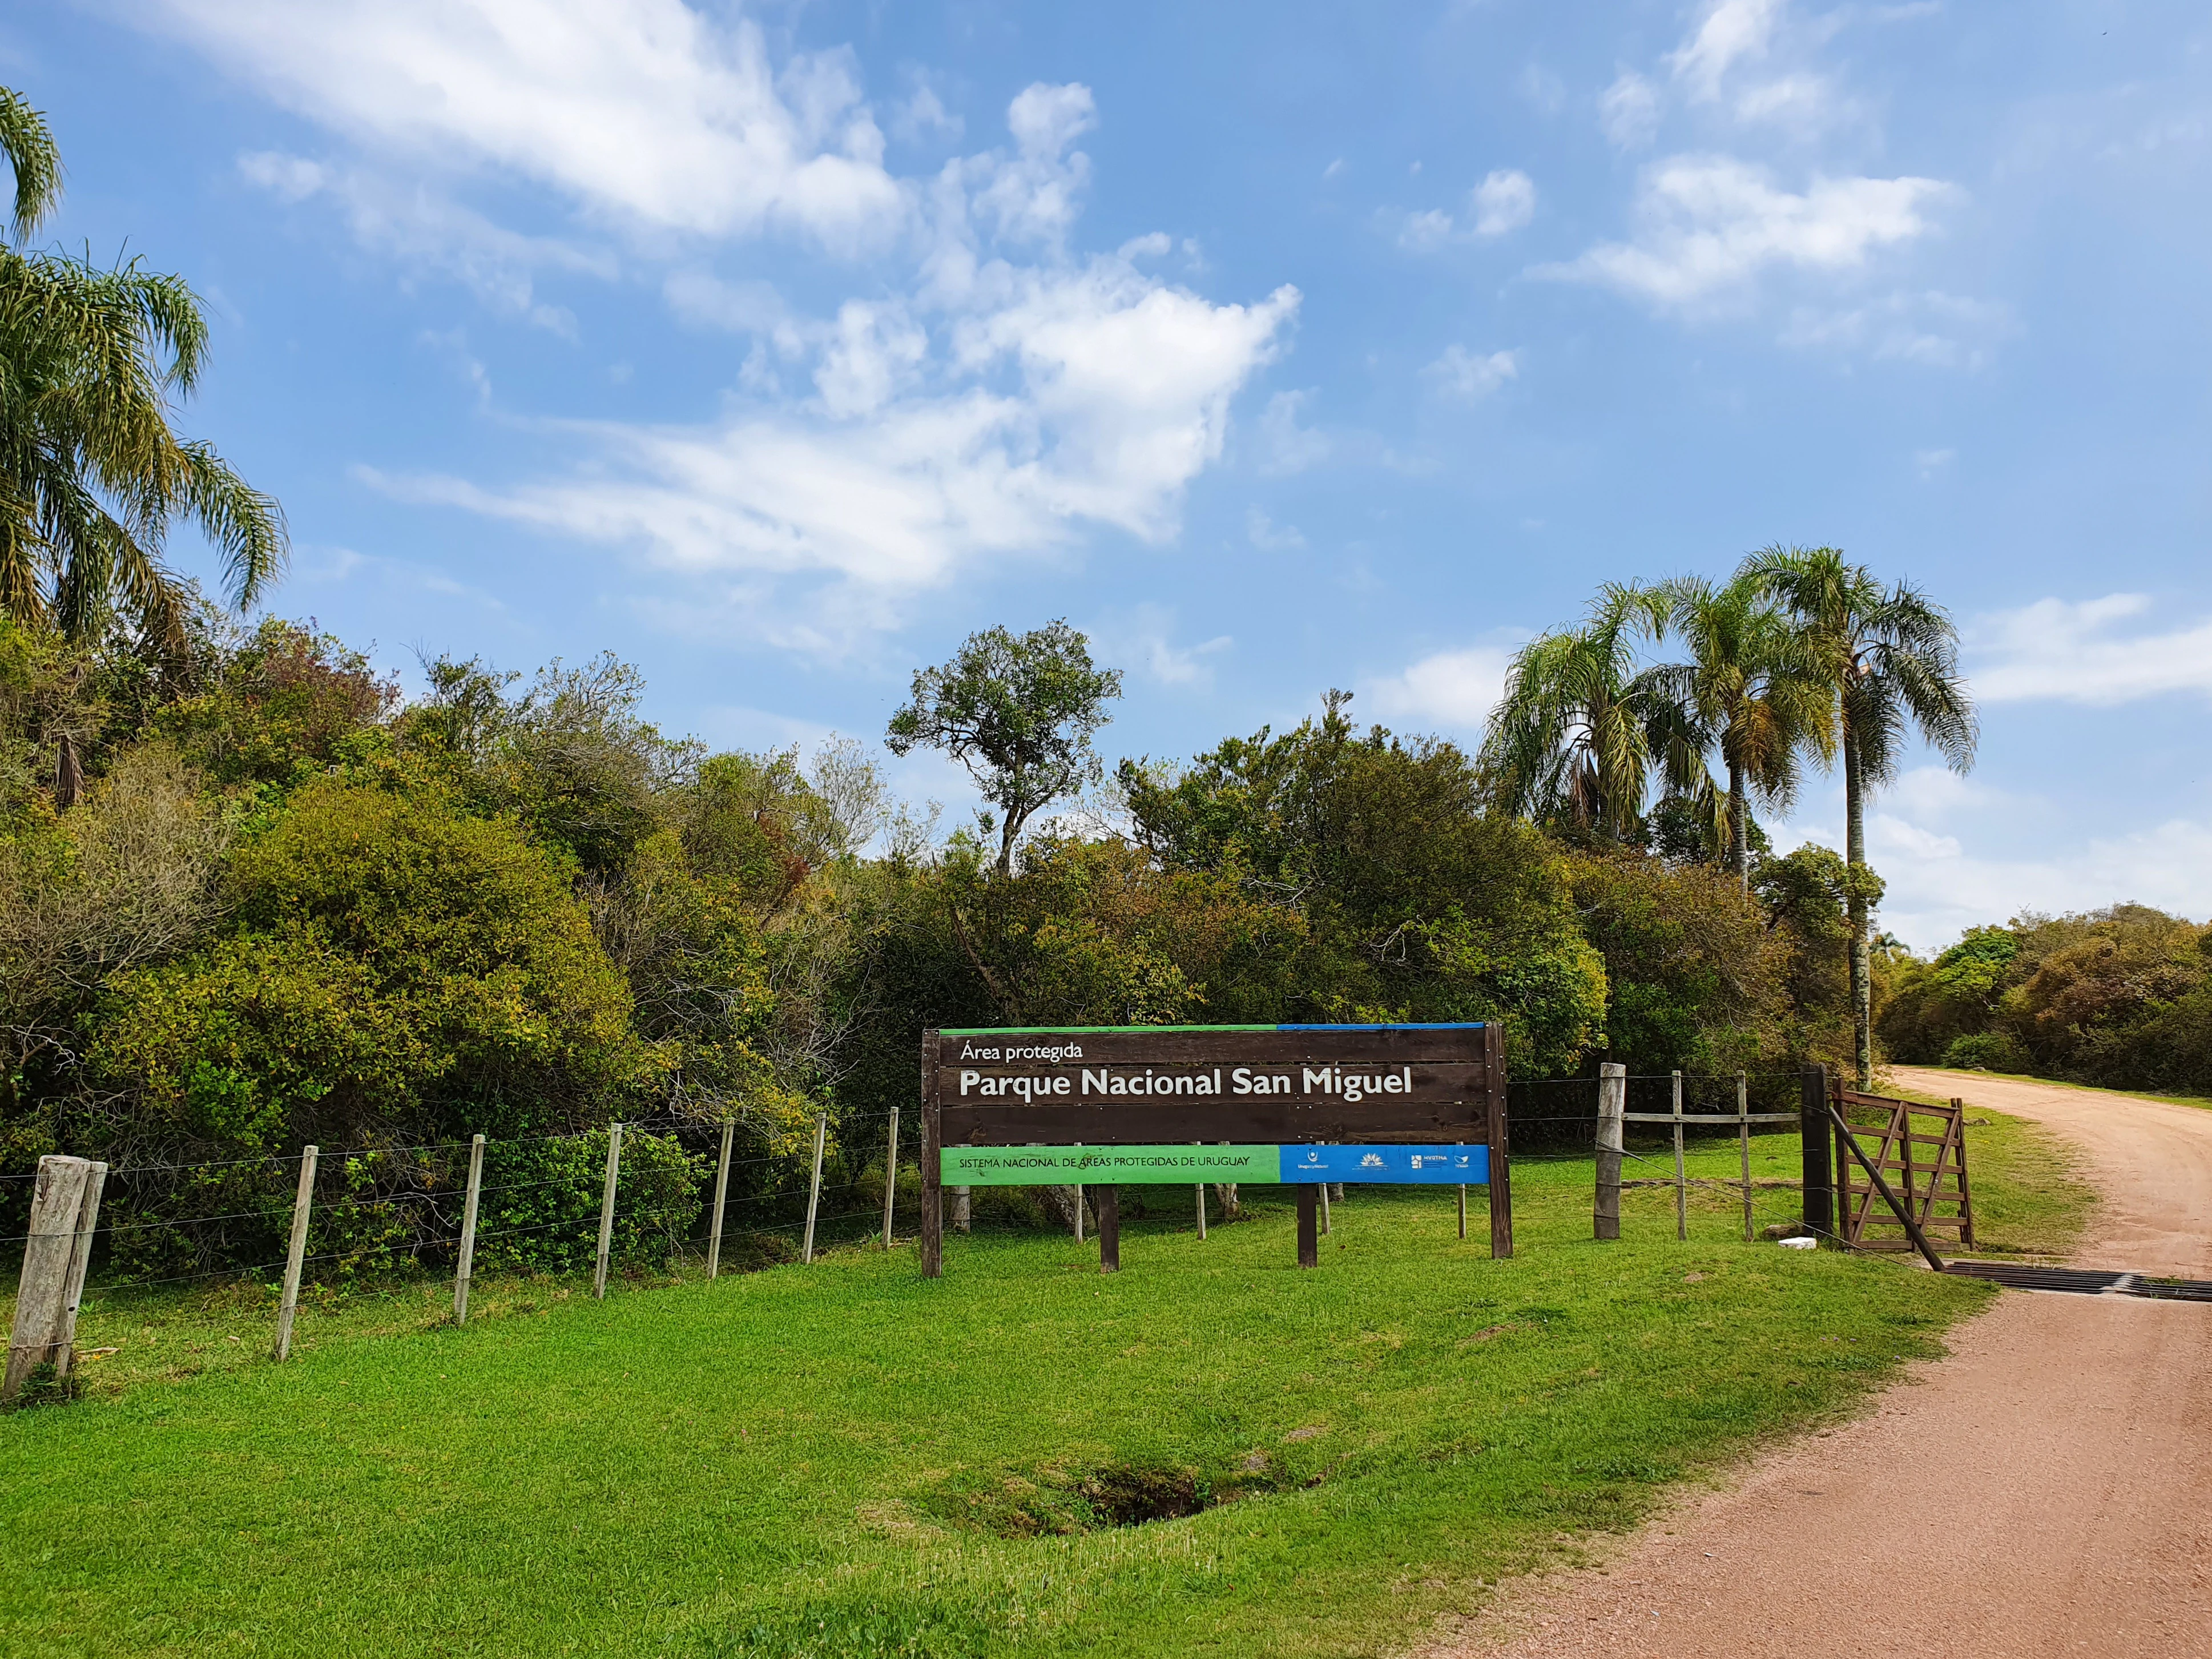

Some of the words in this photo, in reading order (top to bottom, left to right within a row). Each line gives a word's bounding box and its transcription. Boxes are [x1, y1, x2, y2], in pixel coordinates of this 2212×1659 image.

[960, 1040, 1001, 1060] Área
[1006, 1041, 1083, 1064] protegida
[960, 1069, 1070, 1104] Parque
[1082, 1068, 1221, 1096] Nacional
[1232, 1068, 1291, 1094] San
[1303, 1066, 1411, 1102] Miguel
[960, 1158, 1001, 1168] SISTEMA
[1003, 1158, 1060, 1168] NACIONAL
[1062, 1158, 1078, 1167] DE
[1114, 1157, 1178, 1166] PROTEGIDAS
[1181, 1157, 1195, 1166] DE
[1198, 1156, 1251, 1166] URUGUAY
